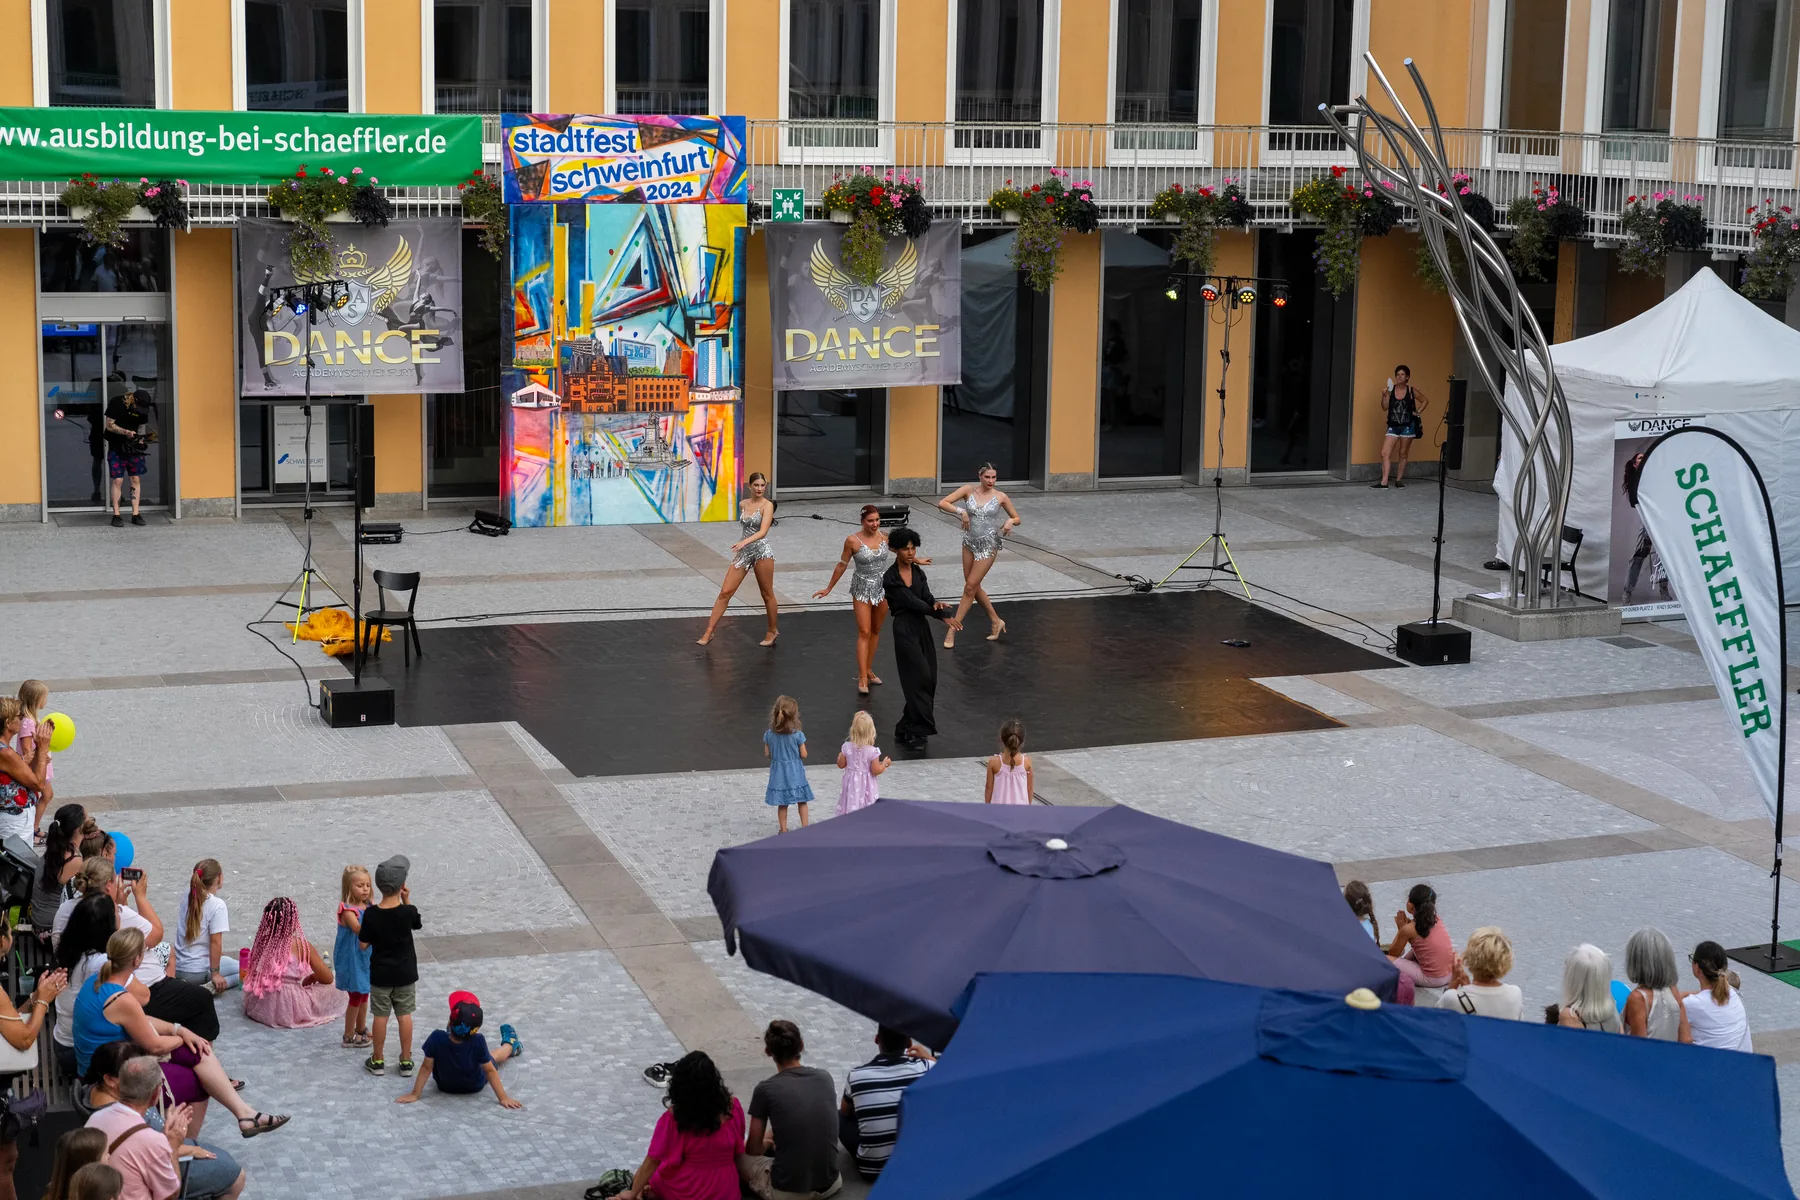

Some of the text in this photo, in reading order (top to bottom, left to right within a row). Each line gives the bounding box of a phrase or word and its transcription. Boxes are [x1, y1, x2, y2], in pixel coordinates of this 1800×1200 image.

[513, 126, 637, 153] stadtfest
[552, 146, 710, 193] schweinfurt
[646, 181, 694, 200] 2024
[860, 302, 869, 316] S
[264, 329, 441, 366] DANCE
[785, 324, 941, 362] DANCE
[1675, 462, 1772, 738] SCHAEFFLER
